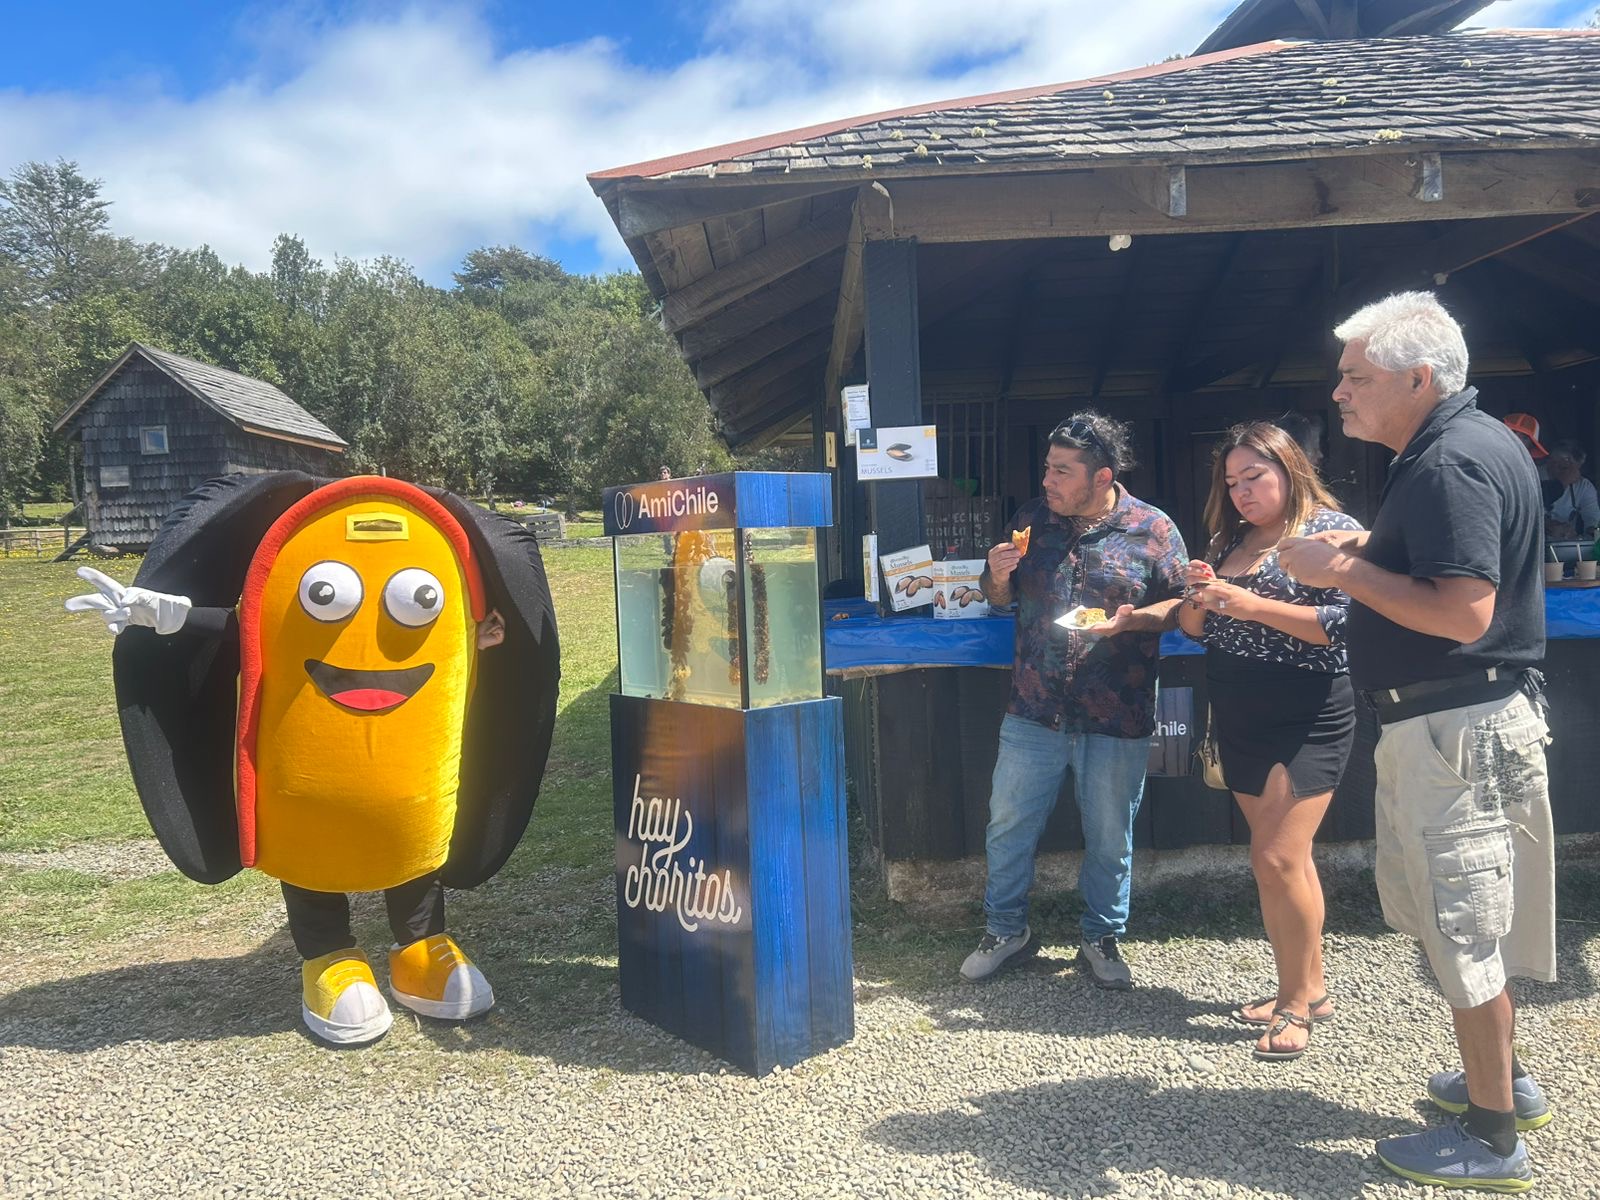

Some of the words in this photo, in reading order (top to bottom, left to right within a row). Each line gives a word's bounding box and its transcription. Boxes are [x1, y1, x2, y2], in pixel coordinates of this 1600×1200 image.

[861, 466, 893, 475] MUSSELS
[638, 486, 718, 519] AmiChile
[1152, 721, 1187, 737] hile
[628, 773, 693, 874] hay
[625, 843, 742, 932] choritos
